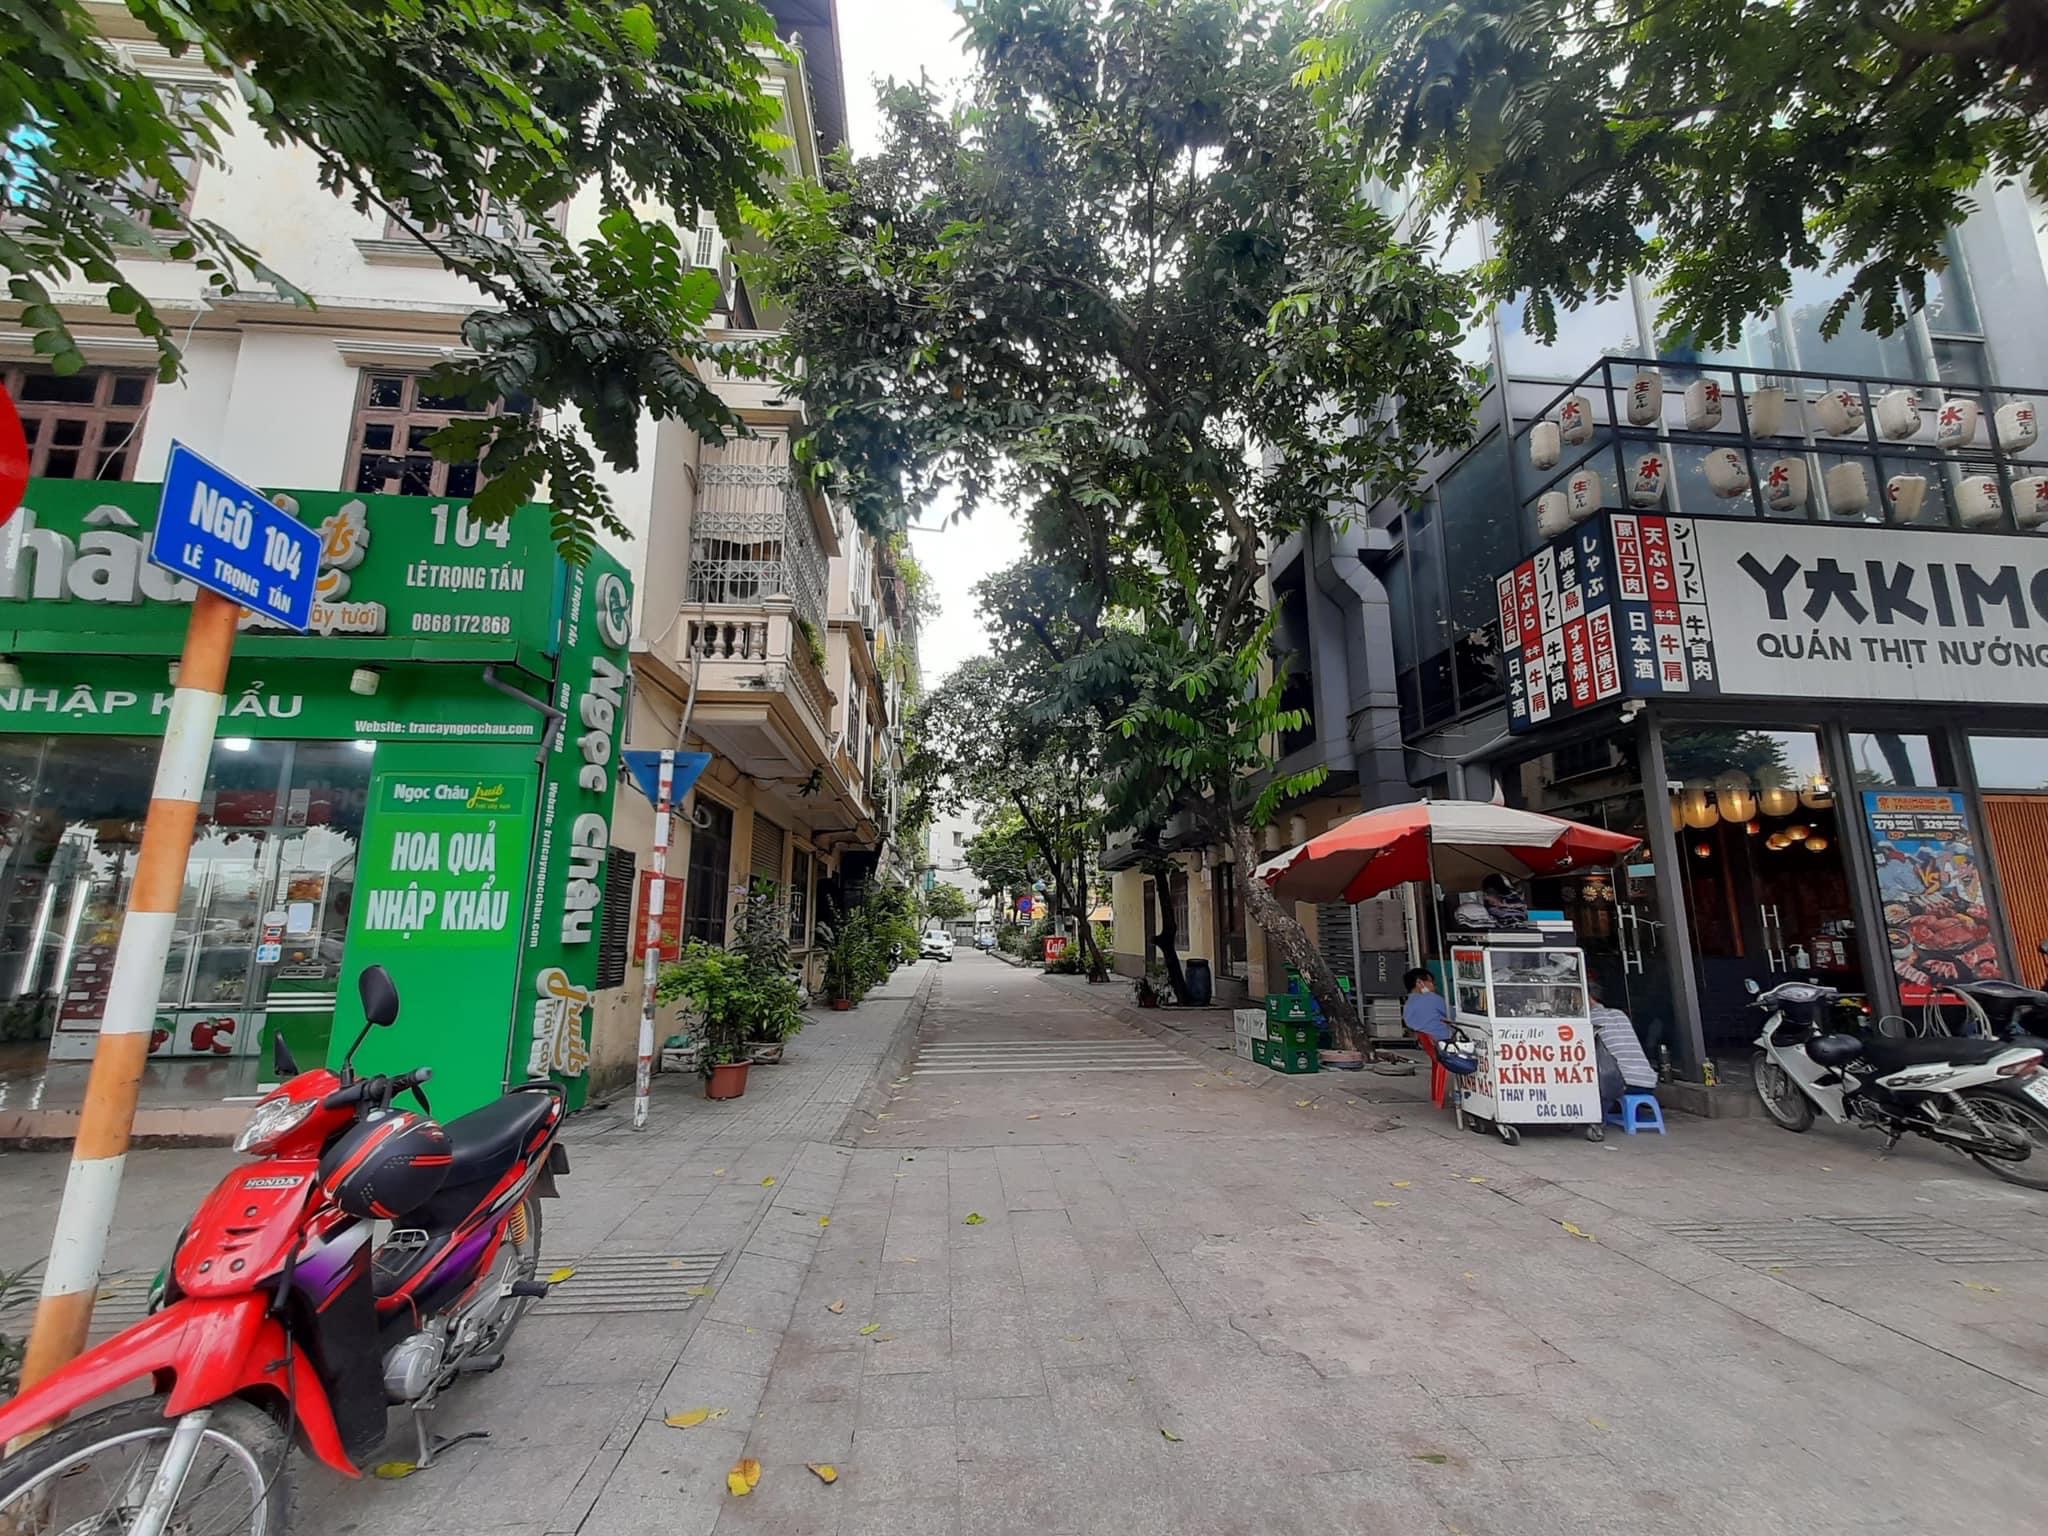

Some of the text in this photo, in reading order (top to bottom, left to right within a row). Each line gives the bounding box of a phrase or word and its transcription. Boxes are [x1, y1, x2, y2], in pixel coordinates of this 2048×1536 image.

[189, 481, 254, 551] NGÕ
[263, 525, 303, 581] 104
[430, 504, 511, 548] 104
[406, 559, 525, 592] LÊ TRỌNG TẤN
[1644, 527, 1670, 590] 天ぷら
[183, 543, 292, 614] LÊ TRỌNG TẤN
[1628, 611, 1655, 680] 日本酒
[1756, 629, 1852, 662] QUÁN
[1860, 637, 1928, 669] THỊT
[151, 681, 304, 718] KẨU
[1508, 658, 1526, 719] 日本酒
[355, 719, 406, 734] Website:
[393, 784, 431, 803] Ngọc
[434, 784, 470, 800] Châu
[560, 655, 626, 944] Ngọc Châu
[1873, 820, 1895, 830] 279
[1922, 820, 1944, 830] 329
[391, 820, 497, 876] HOA QUẢ
[365, 875, 510, 940] NHẬP KHẨU
[1500, 1039, 1555, 1062] ĐỒNG
[1559, 1039, 1587, 1062] HỒ
[1500, 1088, 1547, 1102] THAY PIN
[1536, 1102, 1583, 1119] CÁC LOẠI
[245, 1178, 296, 1187] HONDA
